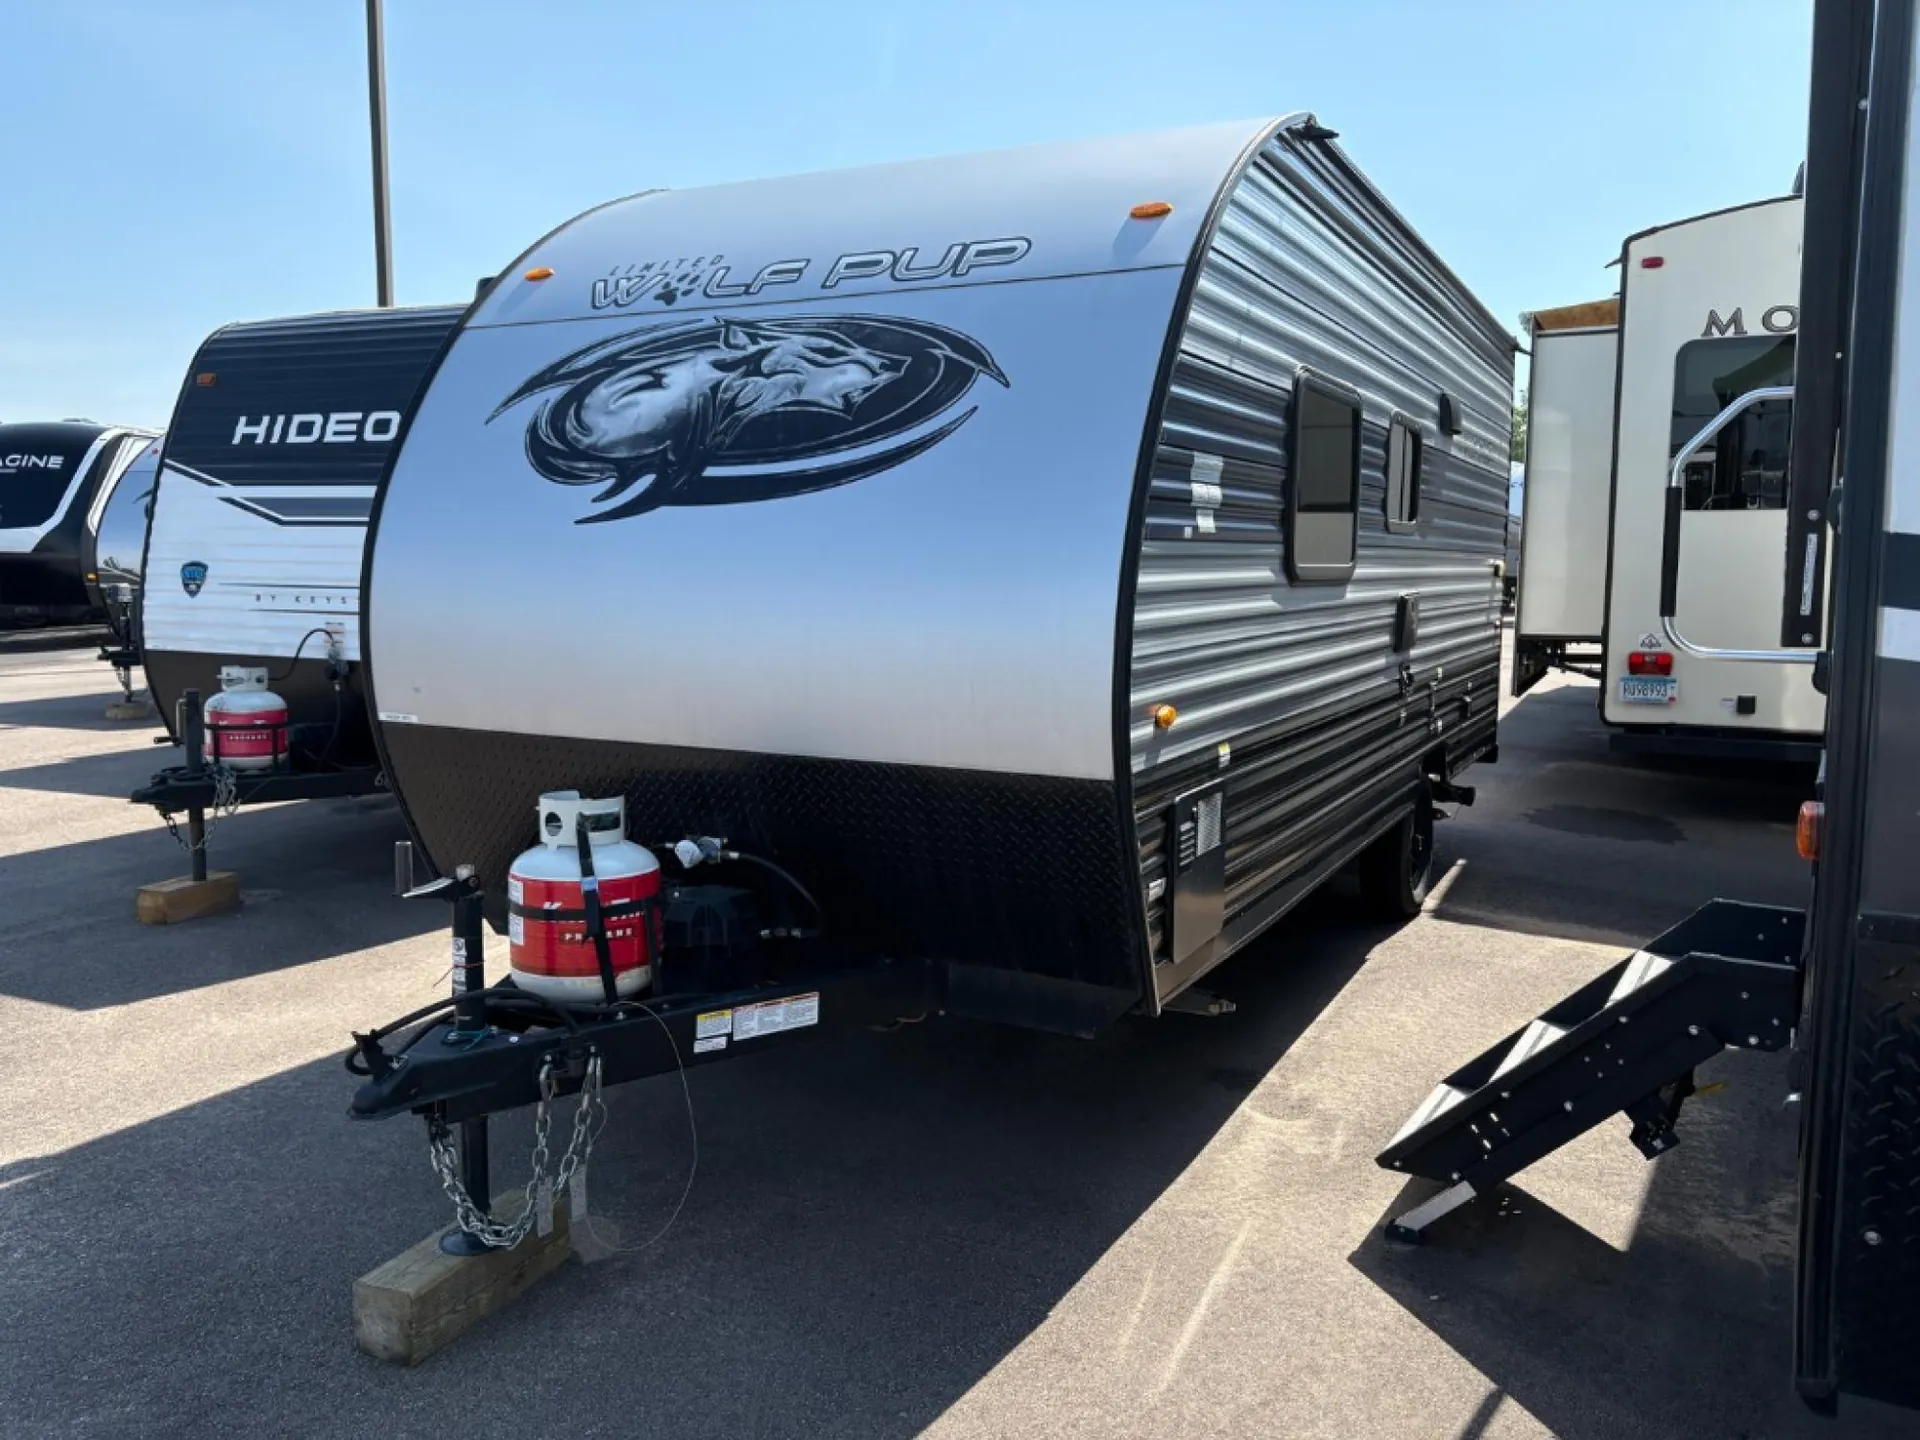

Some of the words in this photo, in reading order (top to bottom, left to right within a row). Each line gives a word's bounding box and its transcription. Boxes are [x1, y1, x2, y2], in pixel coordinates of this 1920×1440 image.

[609, 254, 724, 276] LIMITED
[820, 236, 1032, 289] PUP
[231, 410, 401, 445] HIDEO
[0, 454, 64, 469] GINE
